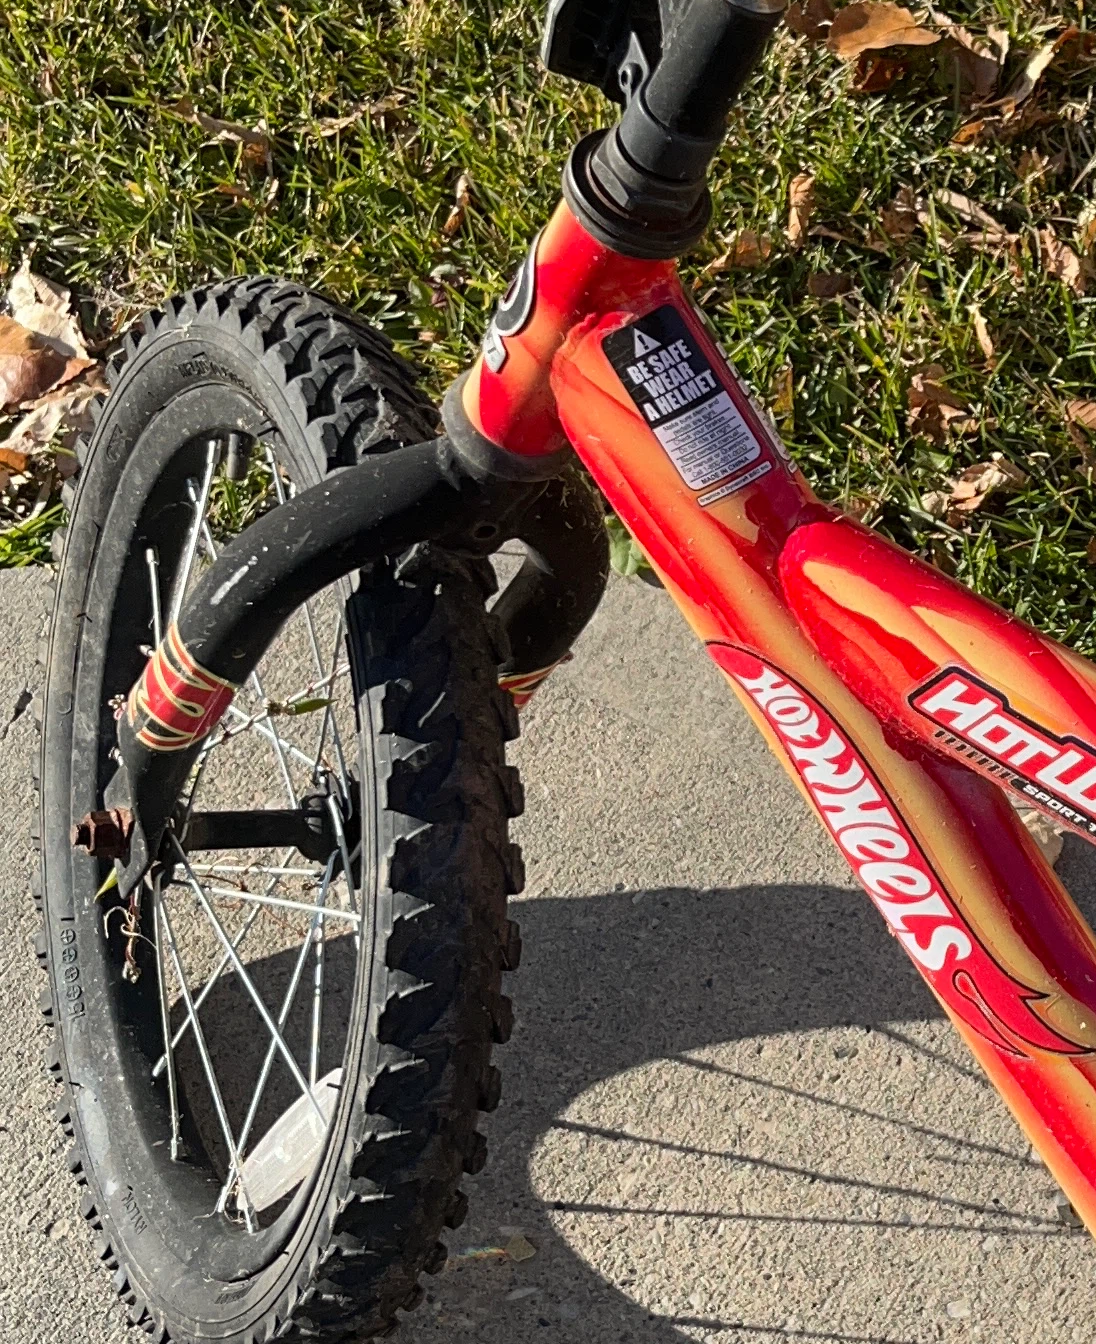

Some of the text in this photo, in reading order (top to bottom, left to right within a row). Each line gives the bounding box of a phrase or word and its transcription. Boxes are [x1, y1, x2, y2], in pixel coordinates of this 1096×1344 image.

[626, 338, 692, 385] BE SAFE
[643, 360, 695, 399] WEAR
[642, 369, 718, 422] A HELMET
[701, 455, 749, 485] MADE IN CHINA
[1022, 782, 1086, 827] SPORT
